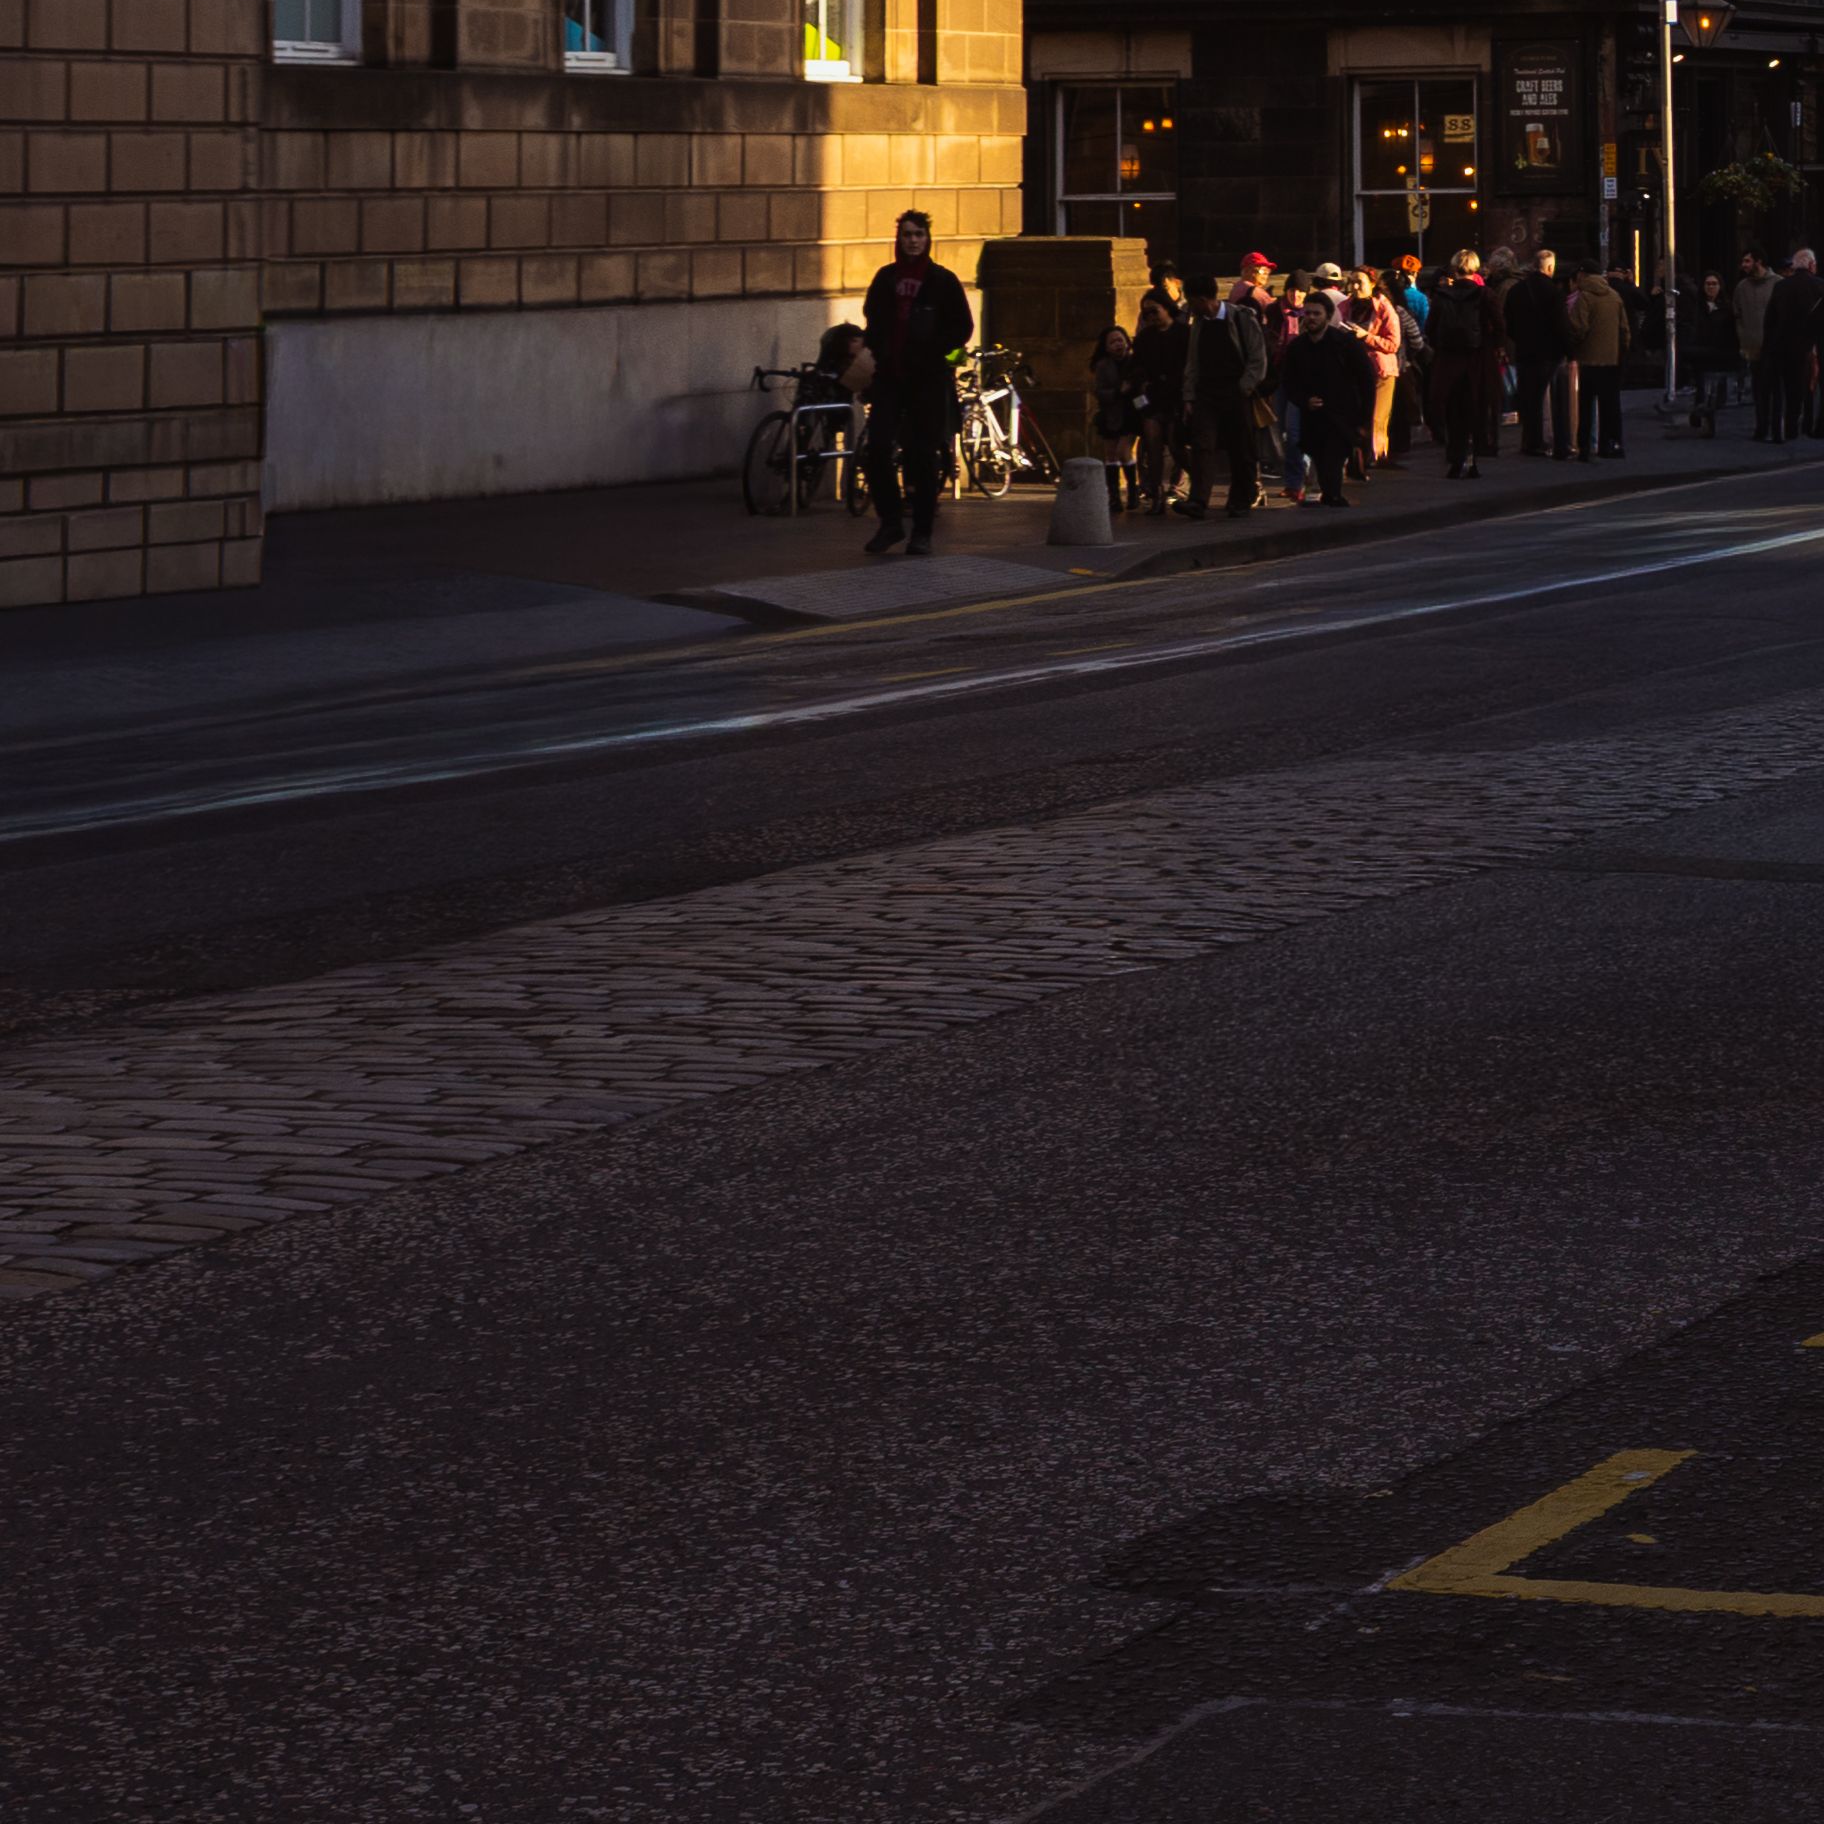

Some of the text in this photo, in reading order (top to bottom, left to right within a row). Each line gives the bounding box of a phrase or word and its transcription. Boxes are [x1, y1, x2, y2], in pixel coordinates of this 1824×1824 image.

[1516, 80, 1563, 92] CRAFT BEERS
[1522, 93, 1557, 105] AND ALES
